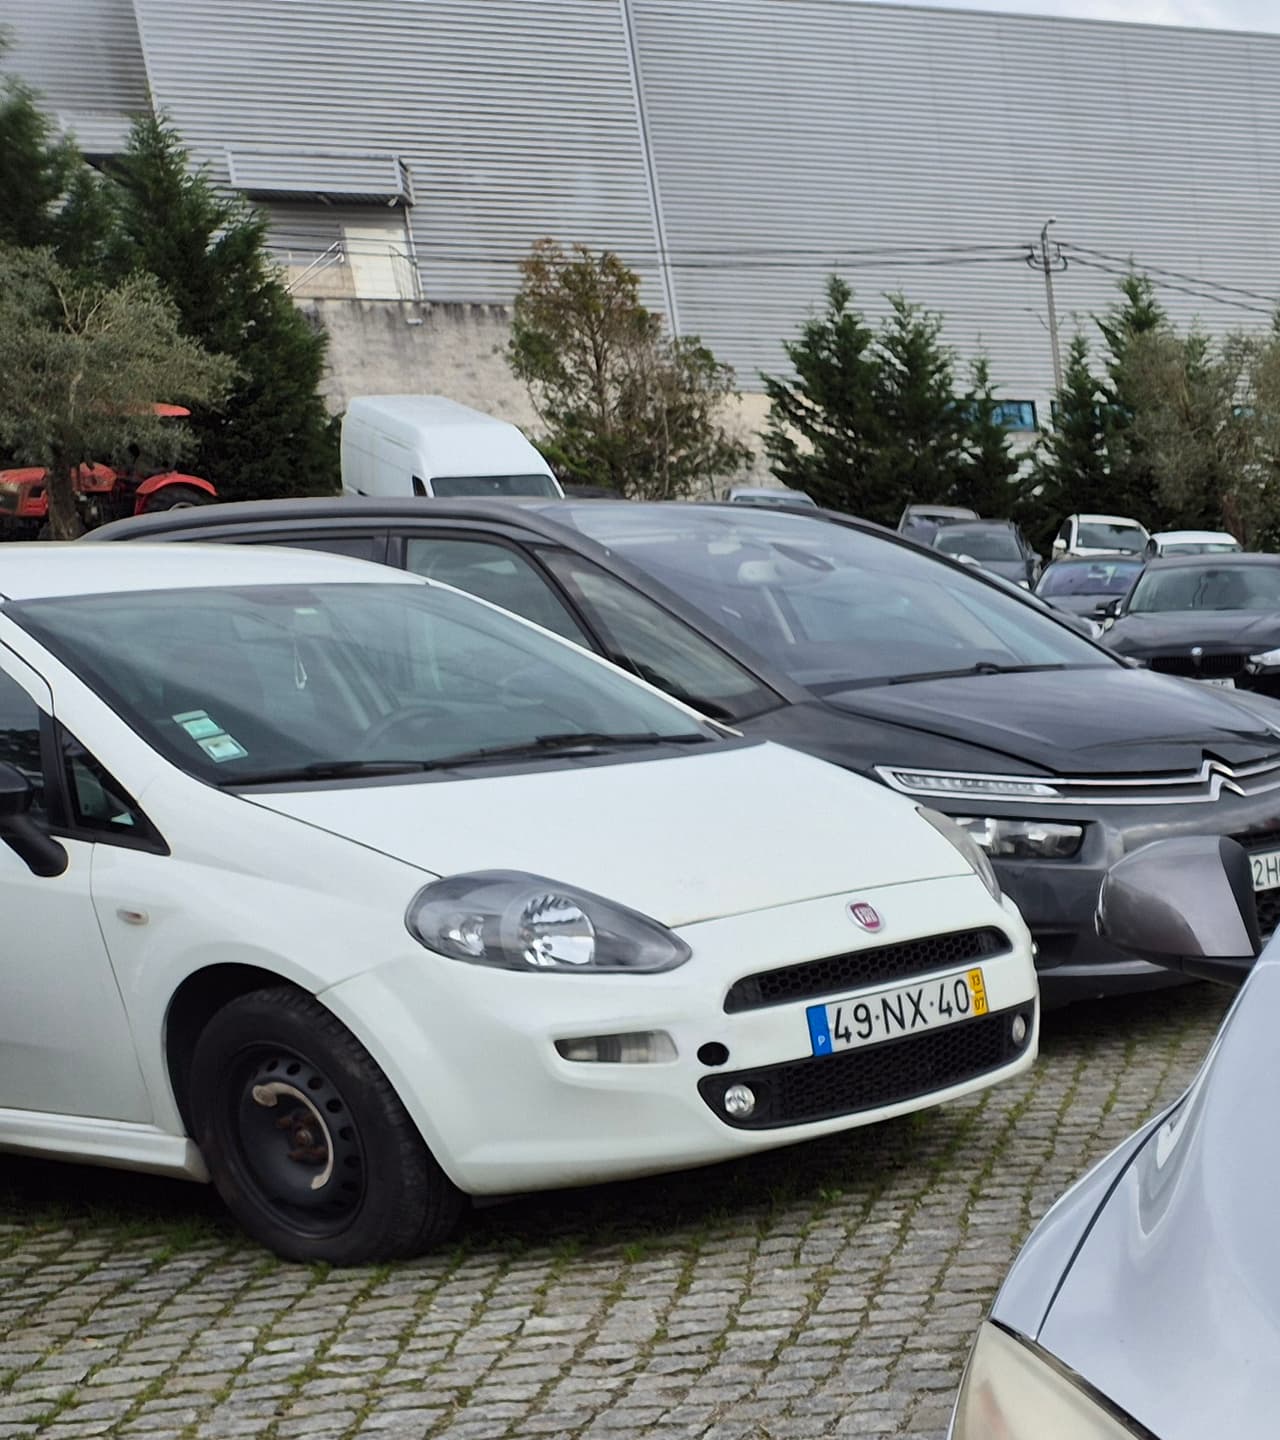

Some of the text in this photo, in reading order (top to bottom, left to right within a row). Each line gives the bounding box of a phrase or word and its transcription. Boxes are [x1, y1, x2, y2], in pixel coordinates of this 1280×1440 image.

[971, 974, 981, 987] 13
[974, 997, 985, 1011] 07
[817, 1035, 826, 1047] P
